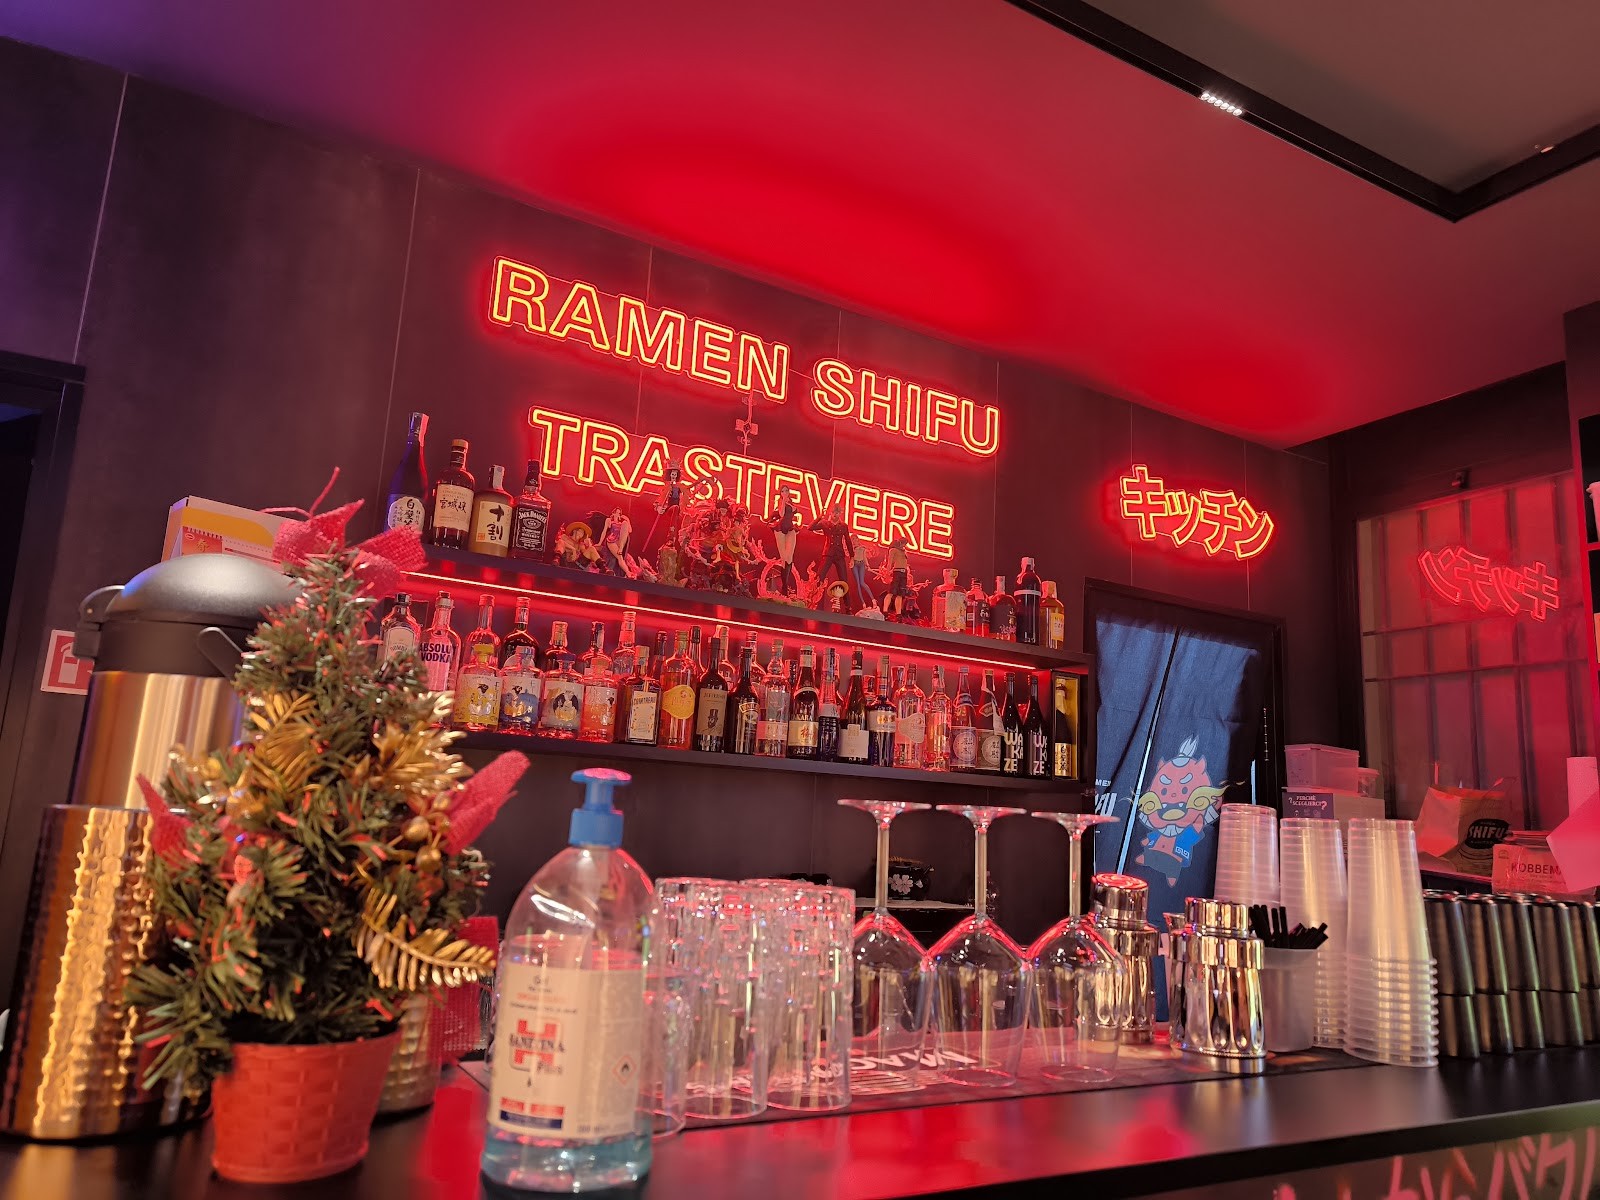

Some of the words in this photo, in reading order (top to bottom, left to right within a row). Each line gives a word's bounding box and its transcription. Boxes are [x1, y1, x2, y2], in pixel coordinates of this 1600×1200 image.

[491, 257, 790, 401] RAMEN
[813, 358, 1000, 457] SHIFU
[530, 408, 955, 559] TRASTEVERE
[518, 511, 530, 519] JACK
[1122, 466, 1275, 559] キッチン
[419, 643, 456, 655] ABSOLUT
[1004, 732, 1024, 746] WA
[1012, 745, 1024, 759] KA
[1003, 758, 1018, 772] ZE
[1033, 761, 1045, 774] ZE
[1468, 825, 1506, 839] SHIFU
